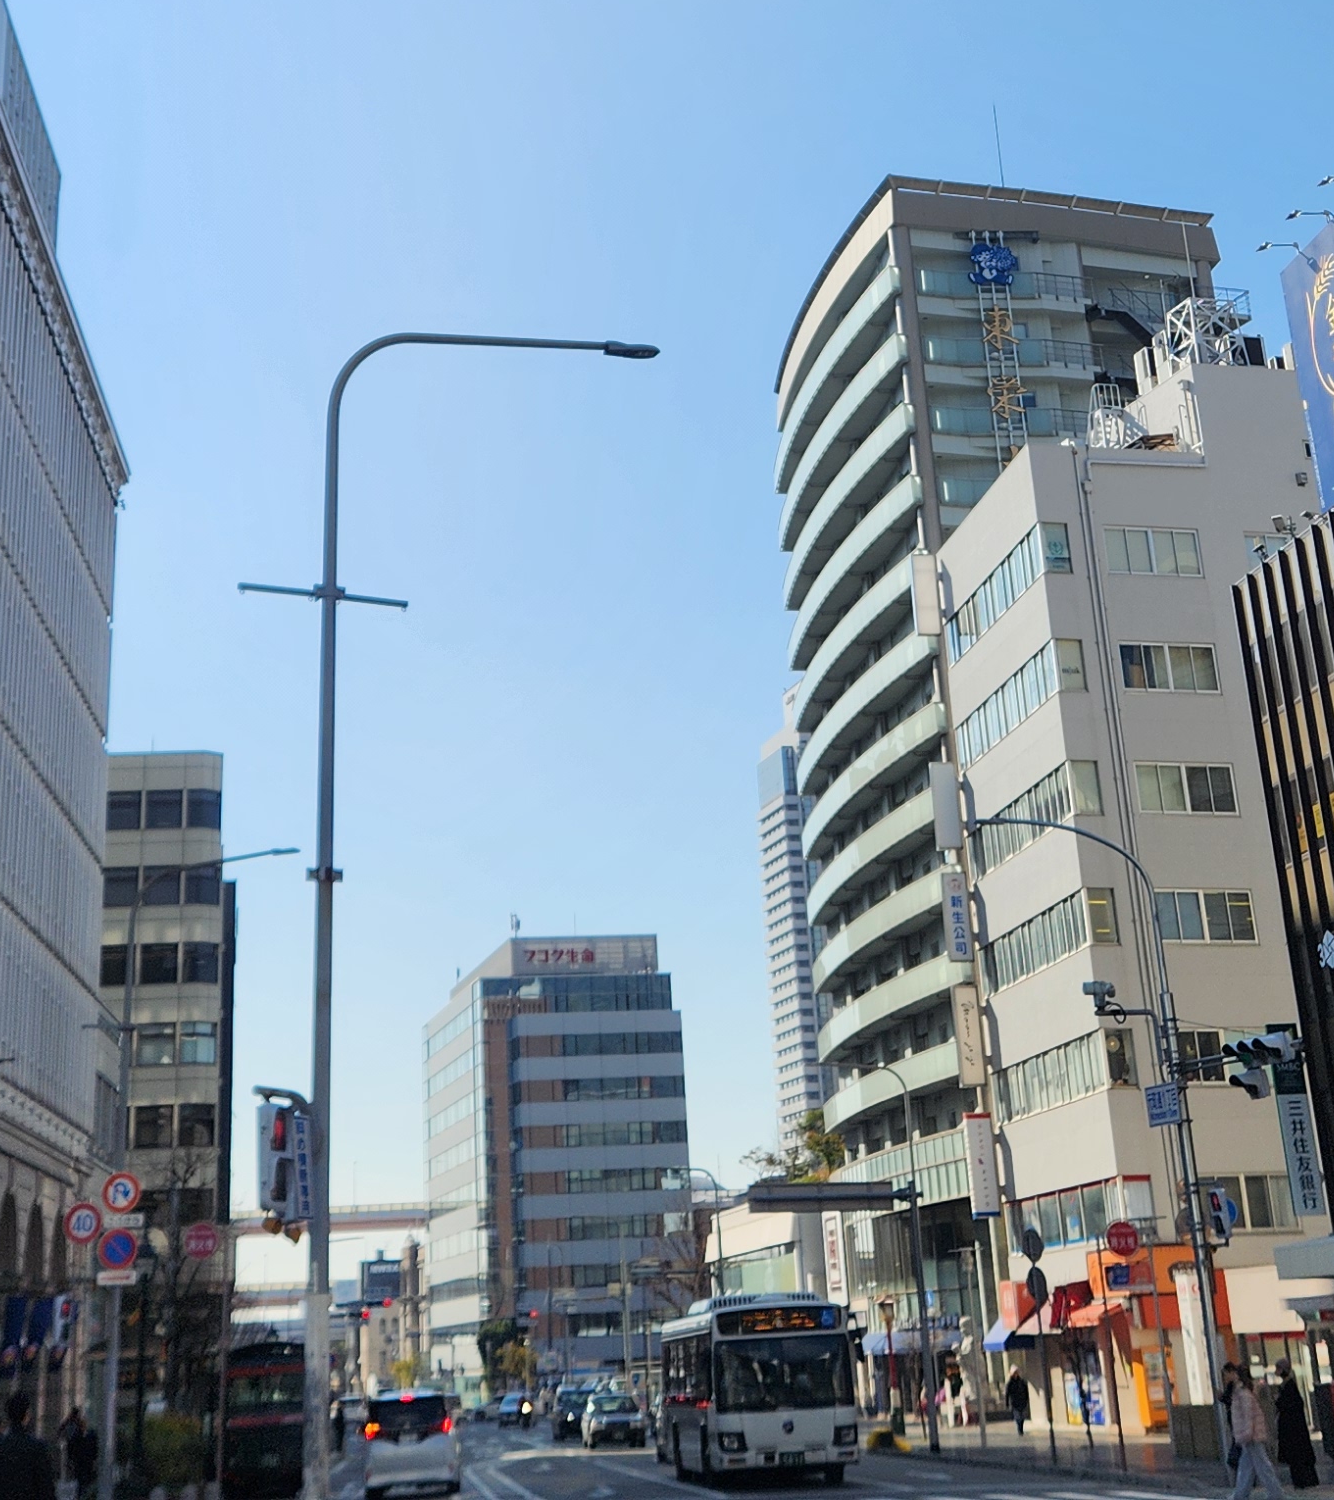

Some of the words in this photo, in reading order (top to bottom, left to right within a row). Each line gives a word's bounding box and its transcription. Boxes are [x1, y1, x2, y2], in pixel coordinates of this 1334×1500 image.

[950, 895, 967, 957] 新生公司
[523, 948, 595, 963] フコク生命
[1287, 1100, 1318, 1210] 三井住友銀行
[72, 1213, 94, 1234] 40
